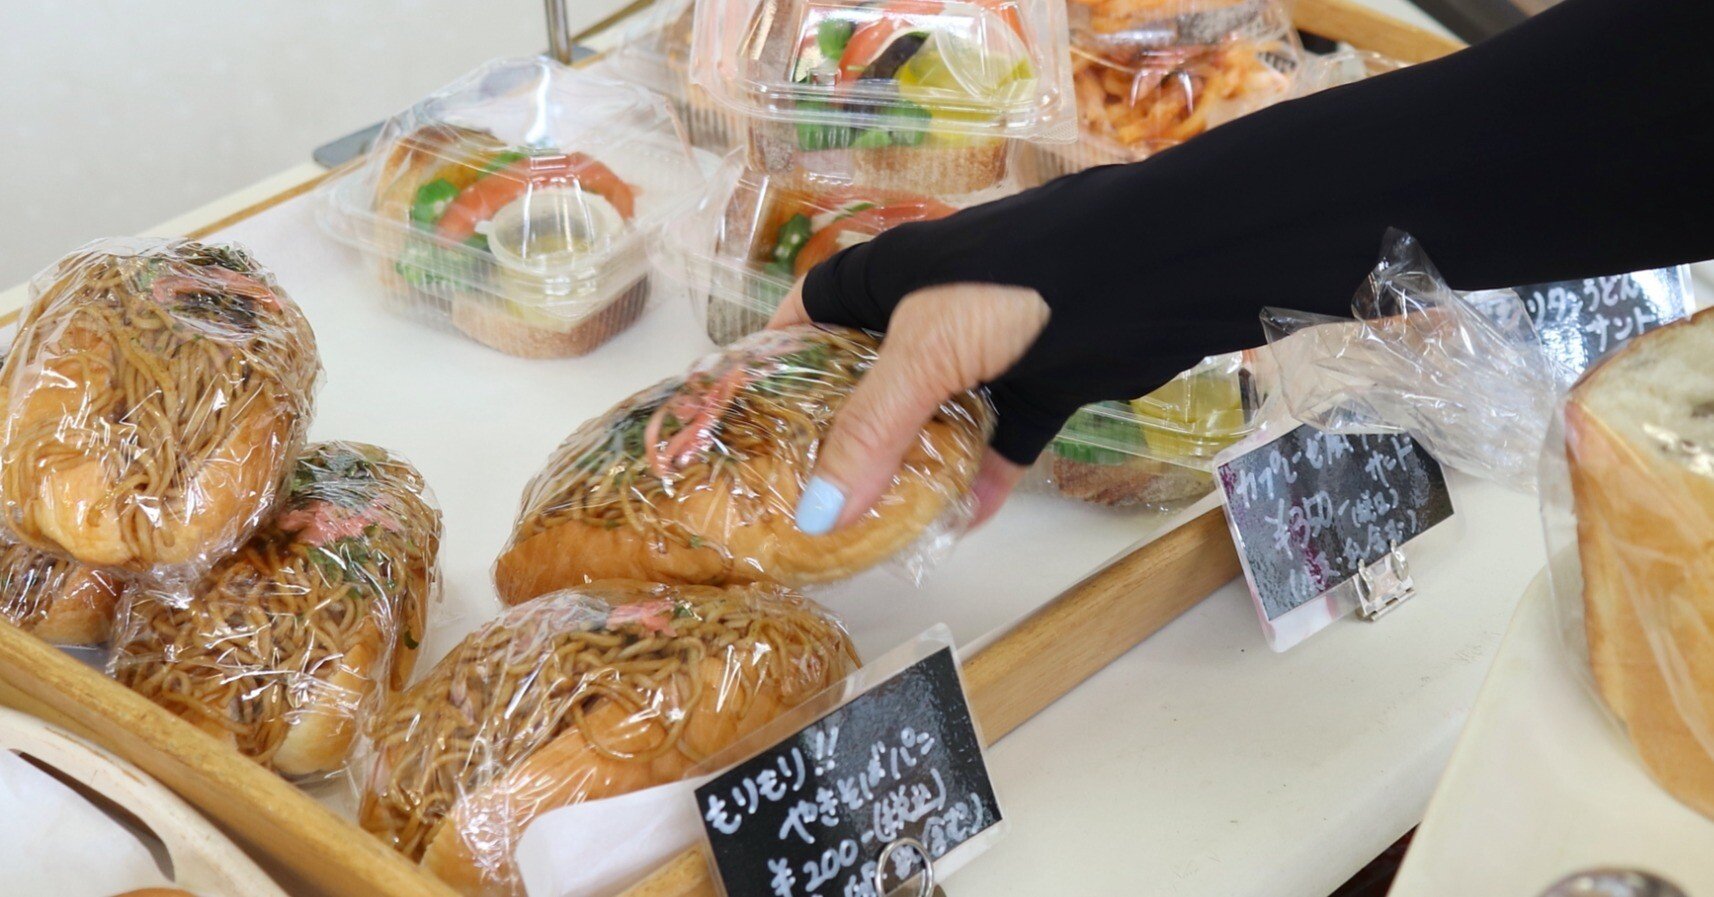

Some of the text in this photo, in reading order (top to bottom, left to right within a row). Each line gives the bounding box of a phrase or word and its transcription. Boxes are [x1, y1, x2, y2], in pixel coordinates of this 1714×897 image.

[706, 726, 839, 835] もりもり!!
[779, 727, 936, 843] やきそばパン
